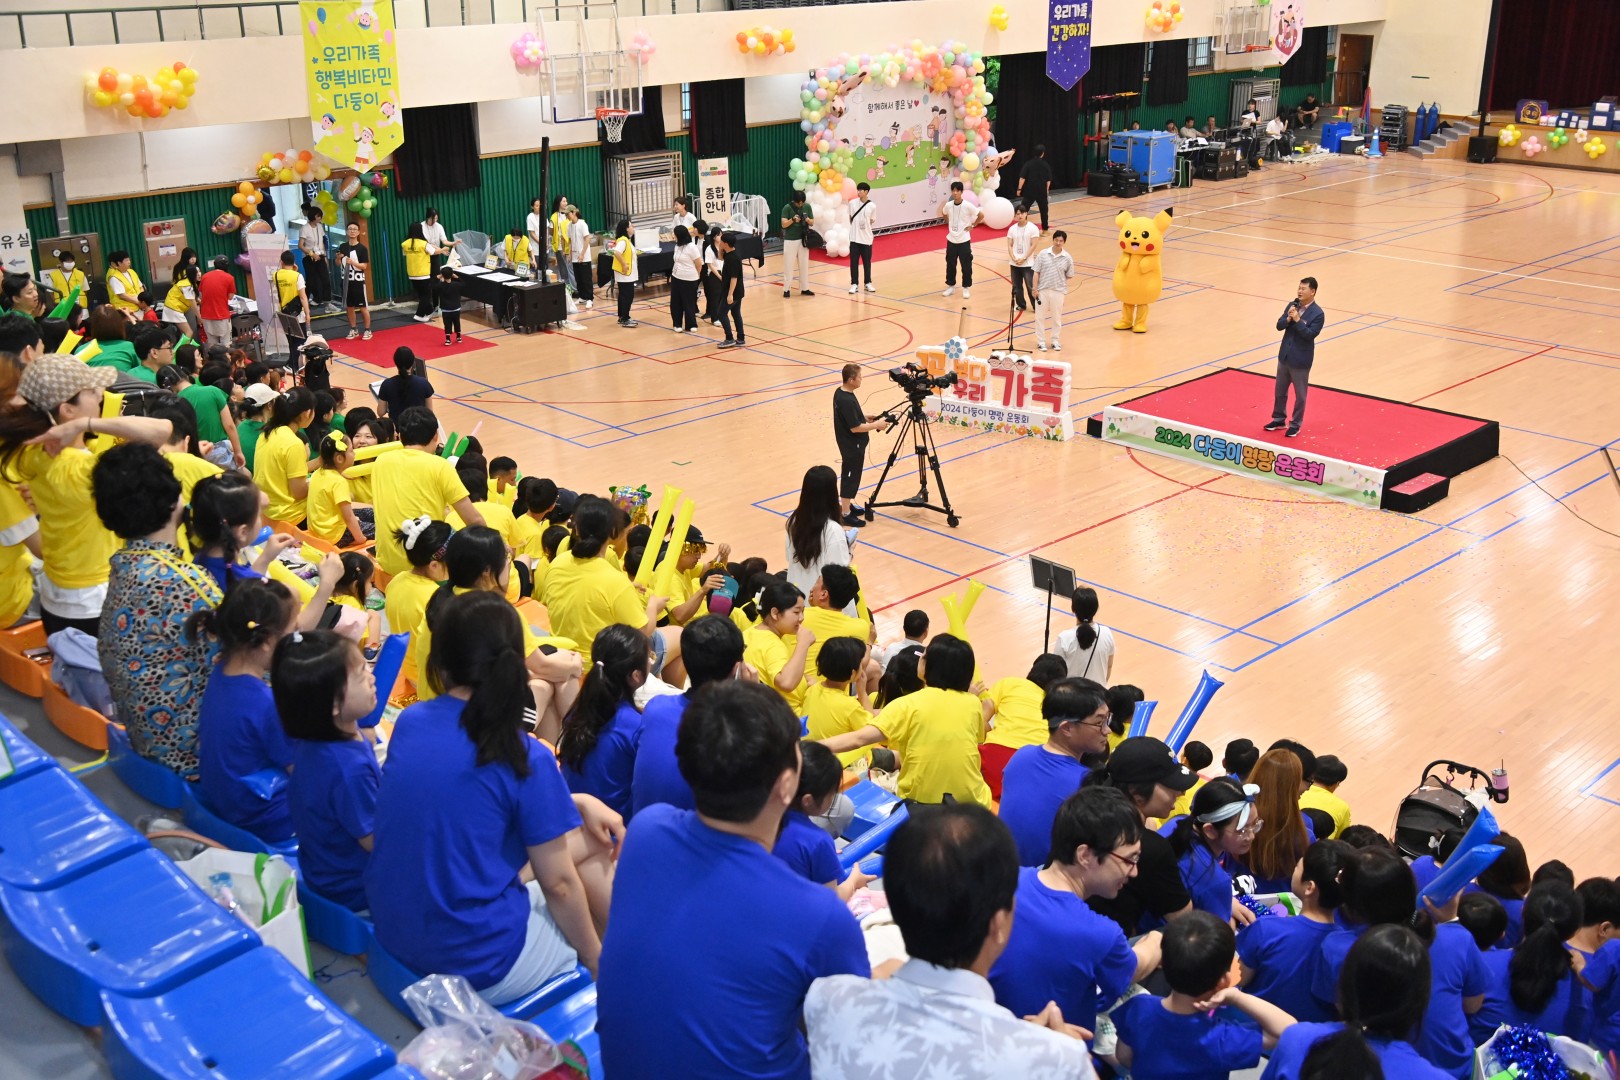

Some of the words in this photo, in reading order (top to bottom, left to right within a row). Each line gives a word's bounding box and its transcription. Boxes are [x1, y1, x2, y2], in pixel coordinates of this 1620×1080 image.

[1053, 2, 1088, 20] 우리가족
[1050, 22, 1090, 42] 건강하자!
[323, 44, 380, 64] 우리가족
[314, 67, 392, 90] 행복비타민
[333, 91, 379, 111] 다둥이
[867, 101, 894, 114] 함께해서
[894, 99, 906, 111] 좋은
[906, 99, 913, 110] 날
[705, 186, 725, 200] 종합
[705, 200, 726, 214] 안내
[952, 378, 986, 402] 우리
[990, 365, 1065, 414] 가족
[940, 403, 961, 413] 2024
[962, 407, 987, 418] 다둥이
[988, 409, 1005, 422] 명랑
[1006, 412, 1030, 424] 운동회
[1154, 426, 1192, 449] 2024
[1193, 434, 1243, 465] 다둥이
[1242, 444, 1276, 473] 명랑
[1274, 453, 1326, 486] 운동회
